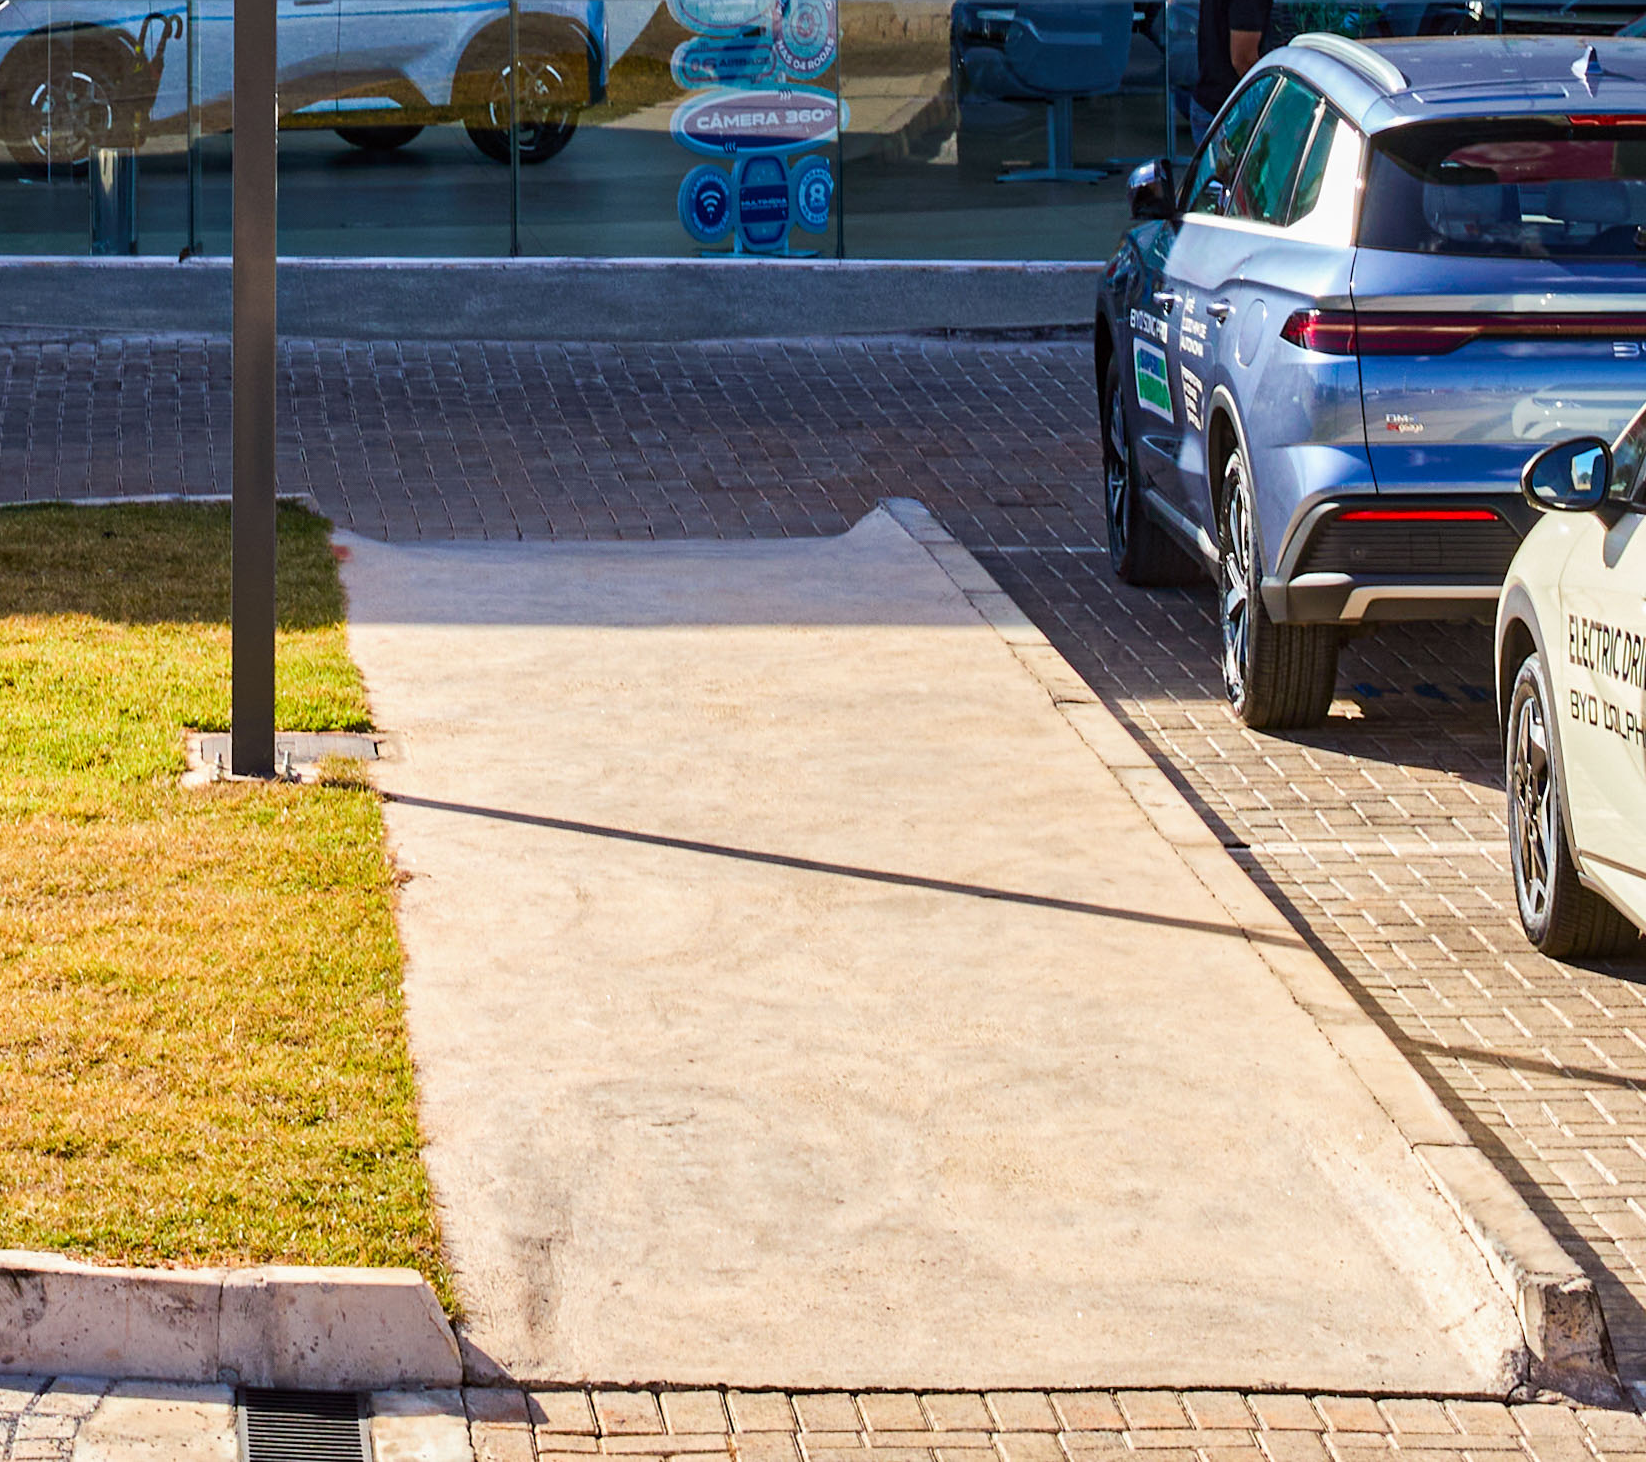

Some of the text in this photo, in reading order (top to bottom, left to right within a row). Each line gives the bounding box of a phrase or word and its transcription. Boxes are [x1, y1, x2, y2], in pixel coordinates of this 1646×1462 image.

[696, 112, 779, 129] CÂMERA
[1569, 613, 1622, 679] ELECTRIC
[1570, 689, 1598, 726] BYD
